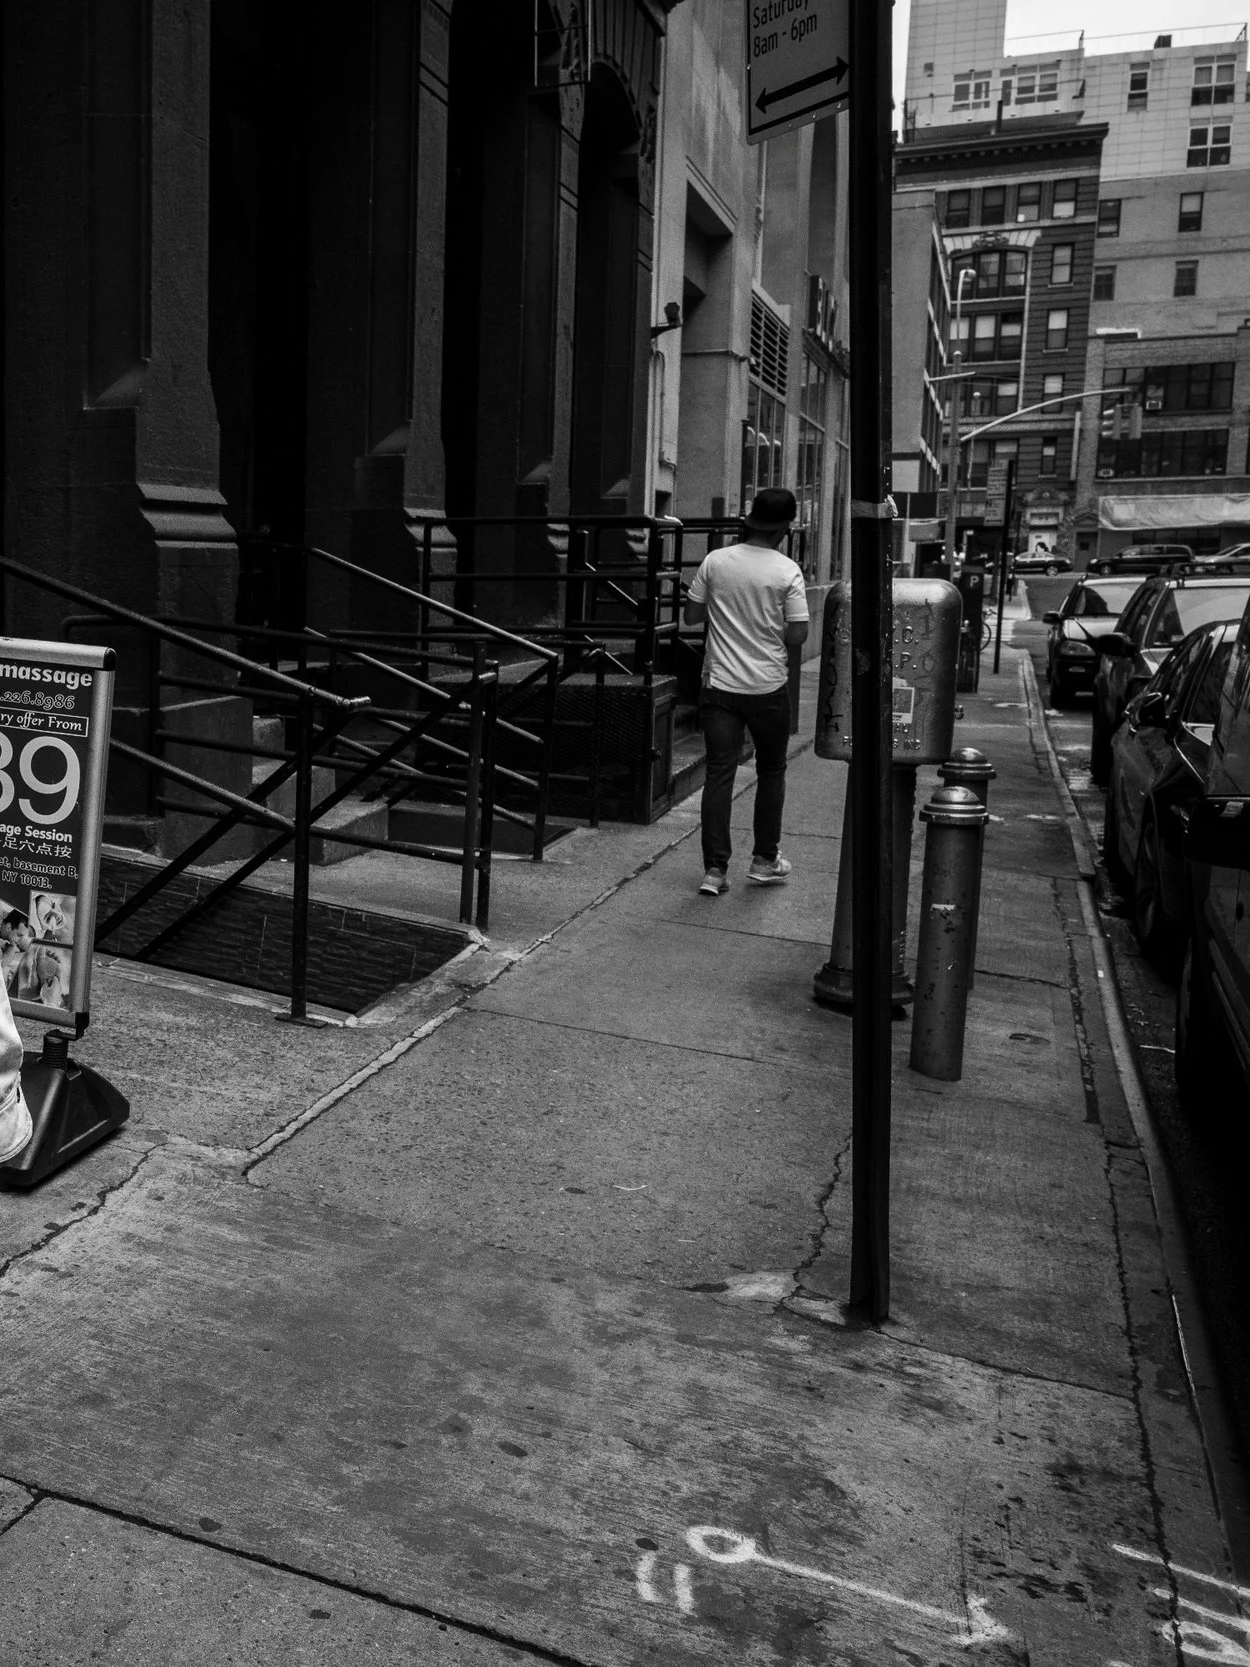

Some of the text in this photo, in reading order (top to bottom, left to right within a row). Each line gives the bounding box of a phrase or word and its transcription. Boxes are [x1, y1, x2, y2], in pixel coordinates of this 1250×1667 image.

[754, 32, 778, 57] 8am
[791, 14, 817, 43] 6pm
[970, 575, 979, 587] P
[17, 711, 44, 729] offer
[48, 716, 83, 732] From
[24, 825, 73, 843] Session
[13, 857, 66, 876] basement
[1, 870, 18, 883] NY
[20, 873, 53, 890] 10013.
